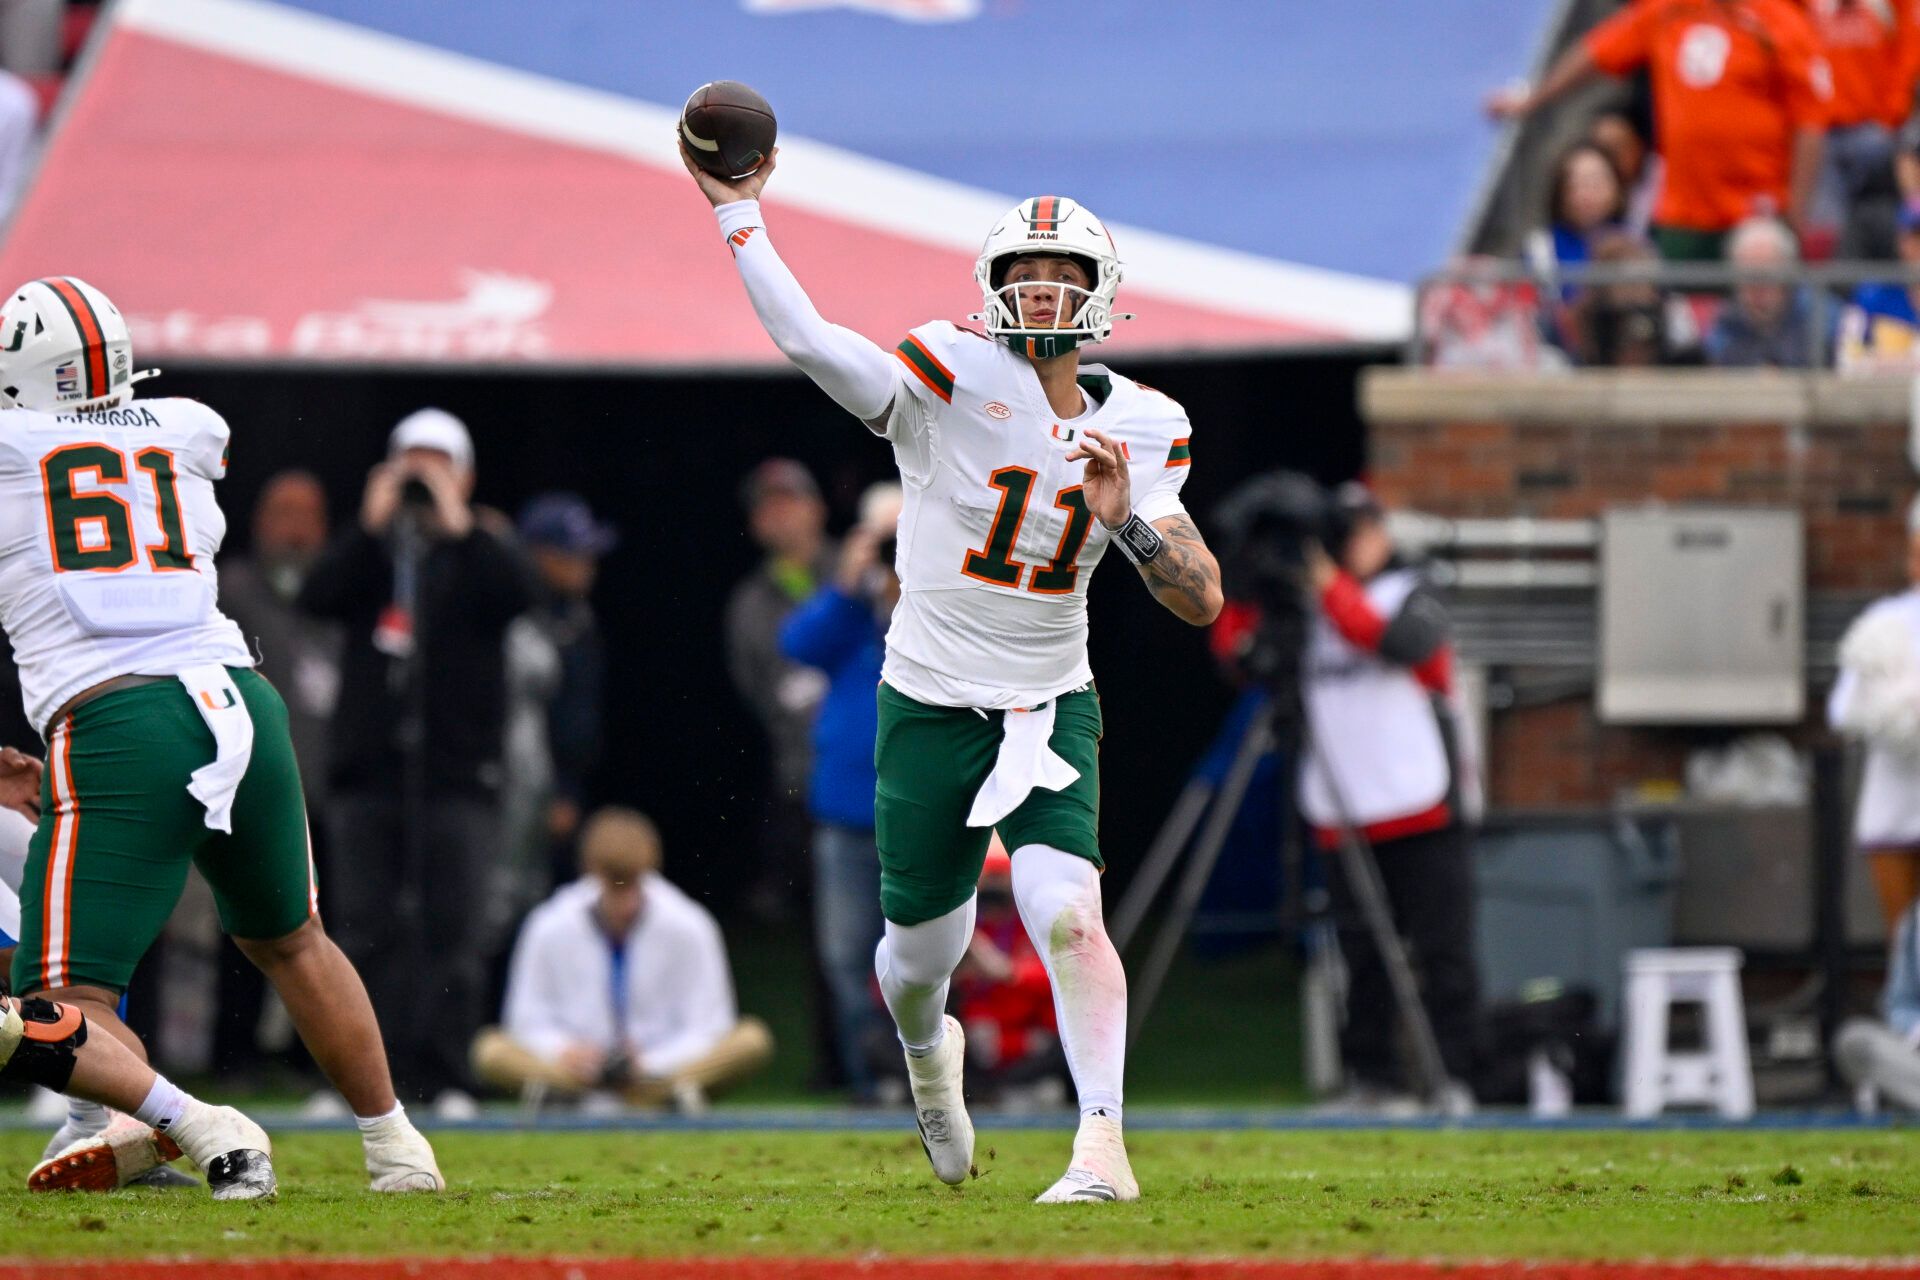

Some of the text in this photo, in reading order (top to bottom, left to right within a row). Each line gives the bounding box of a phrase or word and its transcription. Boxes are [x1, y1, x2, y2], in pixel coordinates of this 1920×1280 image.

[1027, 232, 1059, 241] MIAMI
[1026, 336, 1057, 360] U
[76, 397, 120, 414] MIAMI
[986, 404, 1009, 417] ACC
[1052, 424, 1075, 442] U
[39, 441, 201, 574] 61
[961, 465, 1096, 595] 11
[101, 586, 183, 609] DOUGLAS
[200, 688, 236, 710] U
